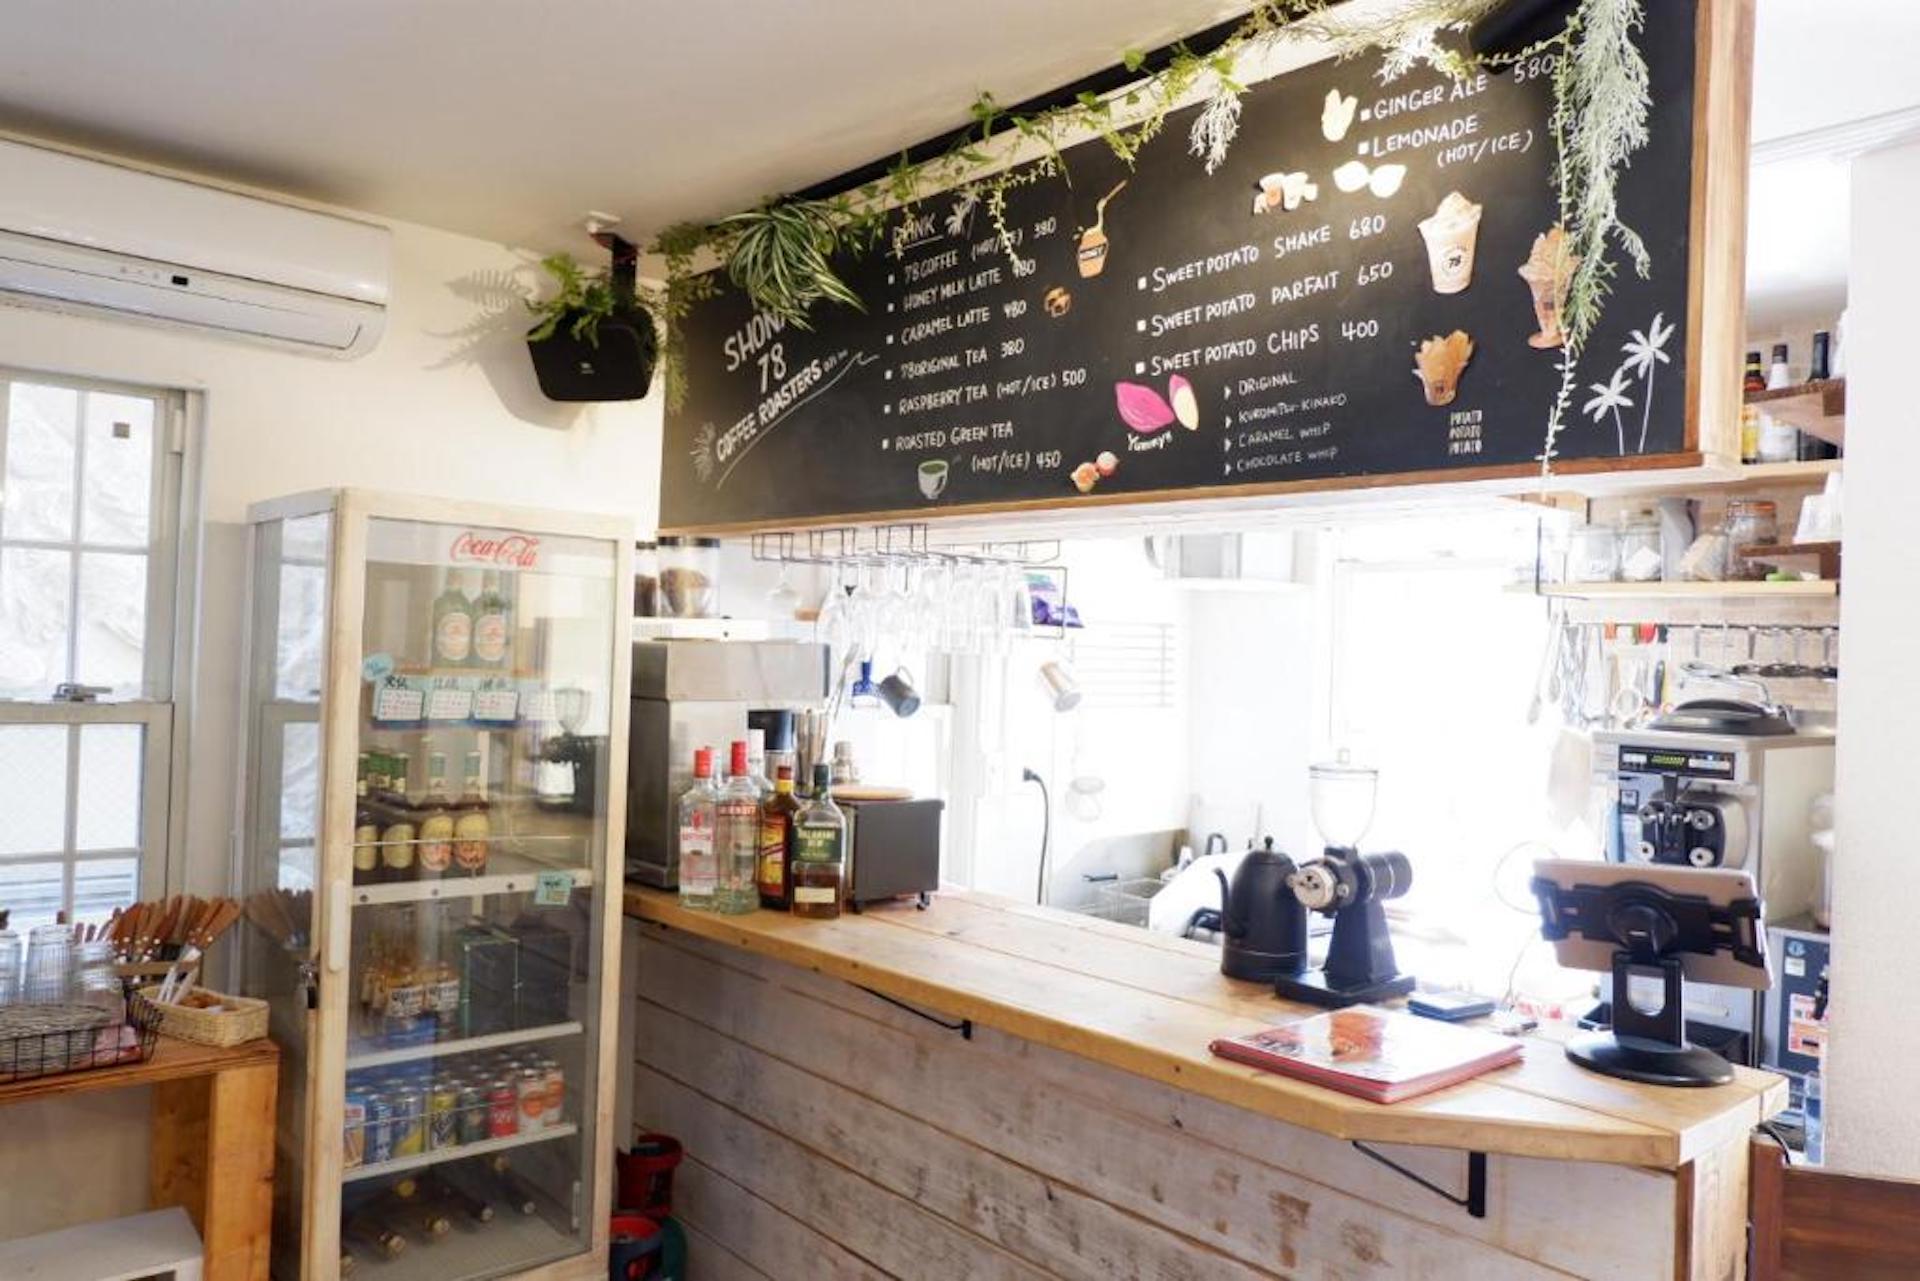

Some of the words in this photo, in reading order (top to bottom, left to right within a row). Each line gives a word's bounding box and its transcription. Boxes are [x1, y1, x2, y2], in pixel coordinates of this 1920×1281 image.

[1374, 86, 1444, 119] GINGER
[1450, 73, 1488, 102] ALE
[1513, 56, 1556, 83] 580
[1373, 114, 1479, 157] LEMONADE
[1437, 130, 1533, 168] (HOT/ICE)
[1034, 216, 1056, 239] 380
[1274, 224, 1331, 258] SHAKE
[1349, 214, 1386, 240] 680
[940, 278, 965, 299] MILK
[968, 267, 1001, 291] LATTE
[1271, 270, 1340, 305] PARFAIT
[1358, 261, 1393, 286] 650
[901, 315, 953, 345] CARAMEL
[957, 306, 990, 328] LATTE
[1267, 323, 1320, 354] CHIPS
[1341, 319, 1379, 341] 400
[965, 344, 988, 366] TEA
[1001, 338, 1025, 358] 380
[899, 387, 962, 416] RASPBERRY
[965, 384, 988, 403] TEA
[997, 374, 1056, 398] (HOT/ICE)
[1062, 368, 1087, 387] 500
[1238, 372, 1298, 396] ORIGINAL
[716, 412, 757, 461] COFFEE
[758, 359, 822, 426] ROASTERS
[896, 431, 945, 450] ROASTED
[951, 425, 988, 445] GREEN
[992, 420, 1013, 439] TEA
[1239, 428, 1293, 447] CARAMEL
[972, 452, 1030, 474] (HOT/ICE)
[1036, 450, 1061, 469] 450
[1237, 451, 1301, 472] CHOCOLATE
[449, 531, 540, 567] Coca-Cola
